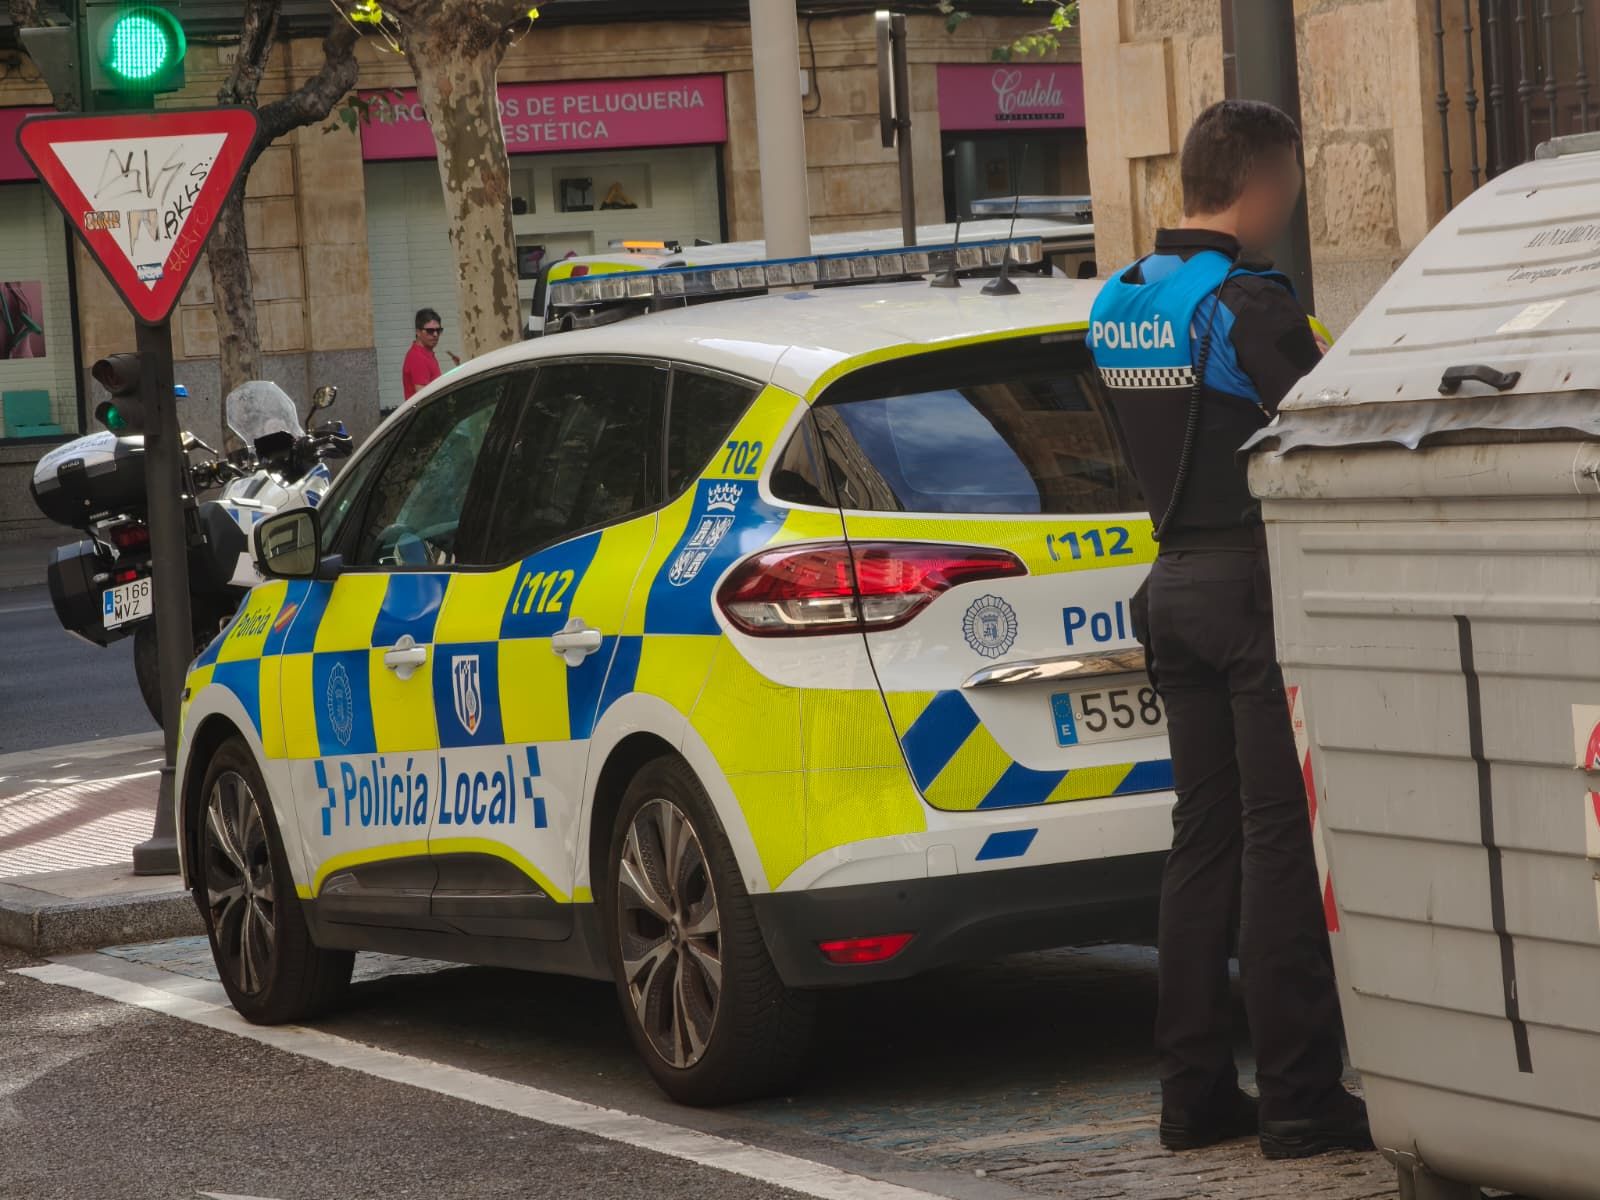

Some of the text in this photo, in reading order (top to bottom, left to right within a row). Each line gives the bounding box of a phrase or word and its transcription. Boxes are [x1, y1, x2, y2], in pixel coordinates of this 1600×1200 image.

[526, 97, 555, 115] DE
[563, 86, 704, 113] PELUQUERÍA
[992, 69, 1063, 113] Castela
[504, 119, 609, 142] ESTÉTICA
[1093, 314, 1175, 349] POLICÍA
[722, 441, 763, 475] 702
[1059, 526, 1133, 559] 112
[114, 582, 148, 604] 5166
[523, 569, 575, 614] 112
[114, 600, 140, 620] MVZ
[1061, 724, 1071, 736] E
[340, 755, 516, 827] Policía Local
